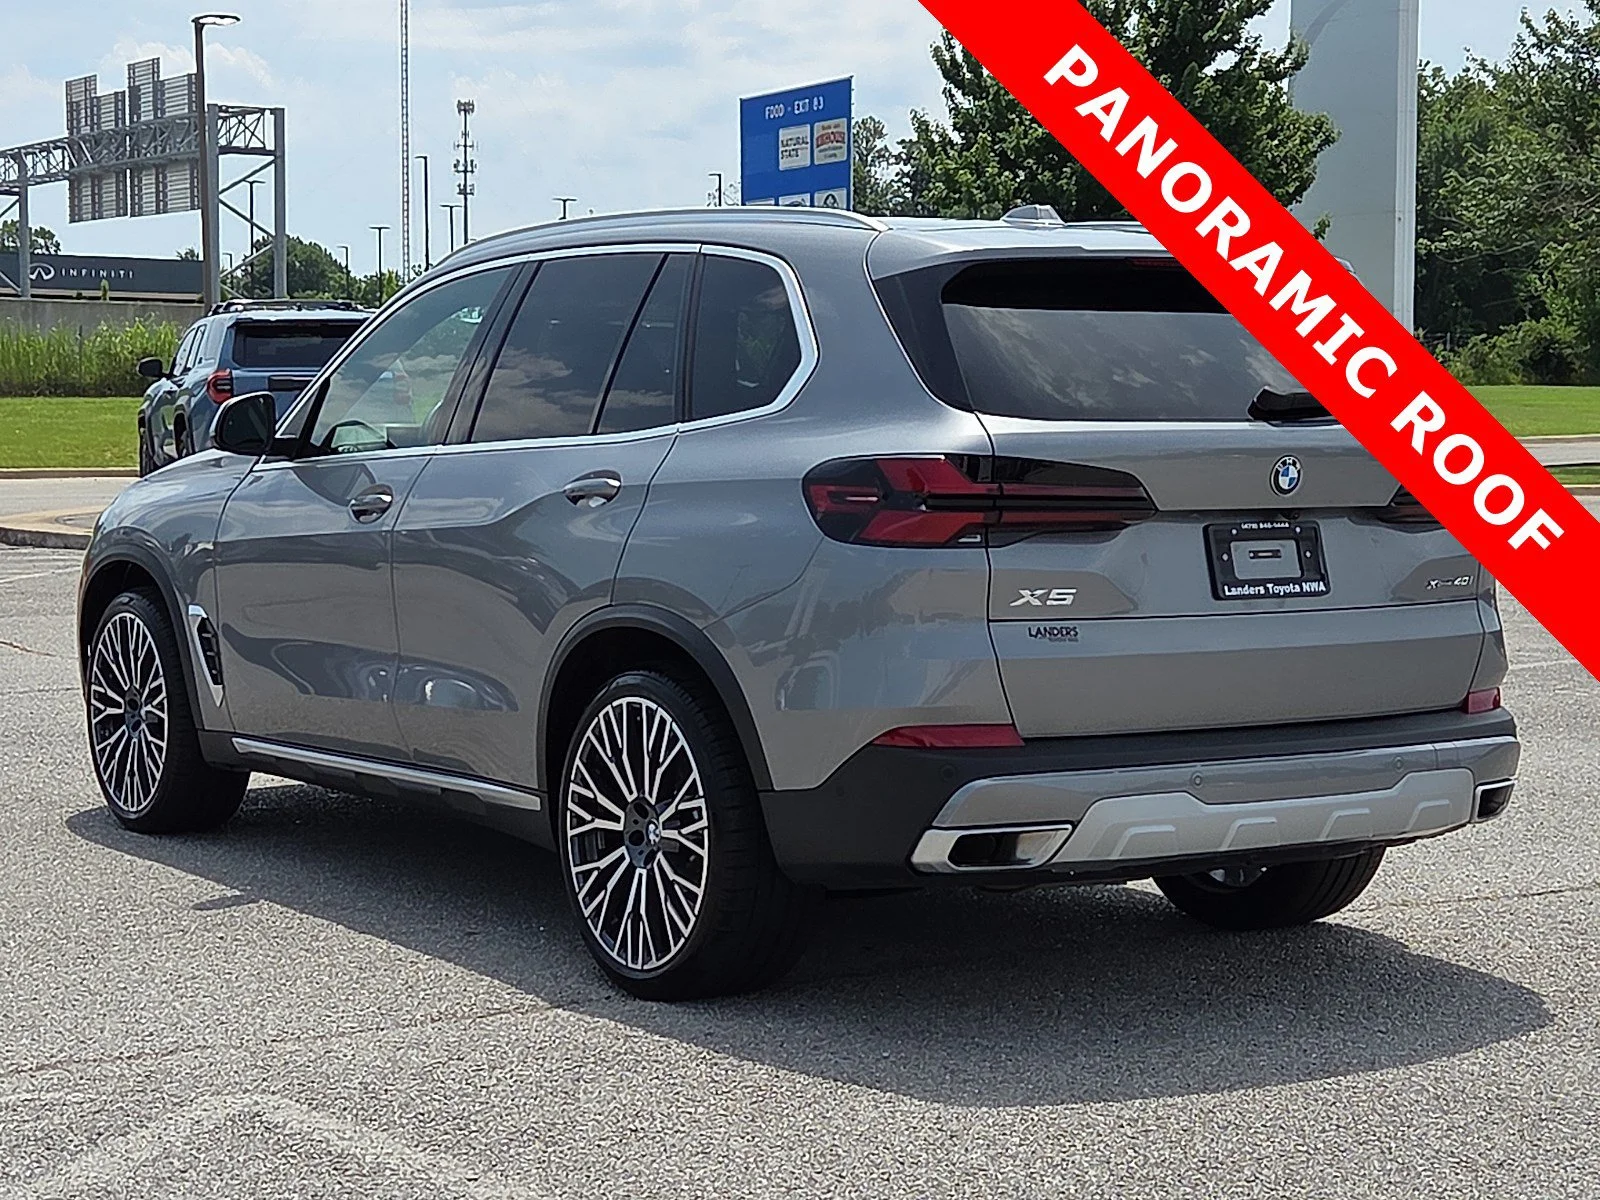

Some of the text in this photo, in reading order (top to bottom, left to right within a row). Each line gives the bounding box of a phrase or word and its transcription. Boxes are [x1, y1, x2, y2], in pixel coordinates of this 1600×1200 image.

[765, 104, 785, 119] FOOD
[794, 99, 809, 114] EXIT
[781, 149, 799, 159] STATE
[61, 267, 134, 279] INFINITI
[1224, 581, 1327, 596] Landers Toyota NWA
[1009, 589, 1077, 606] X5
[1028, 626, 1078, 639] LANDERS
